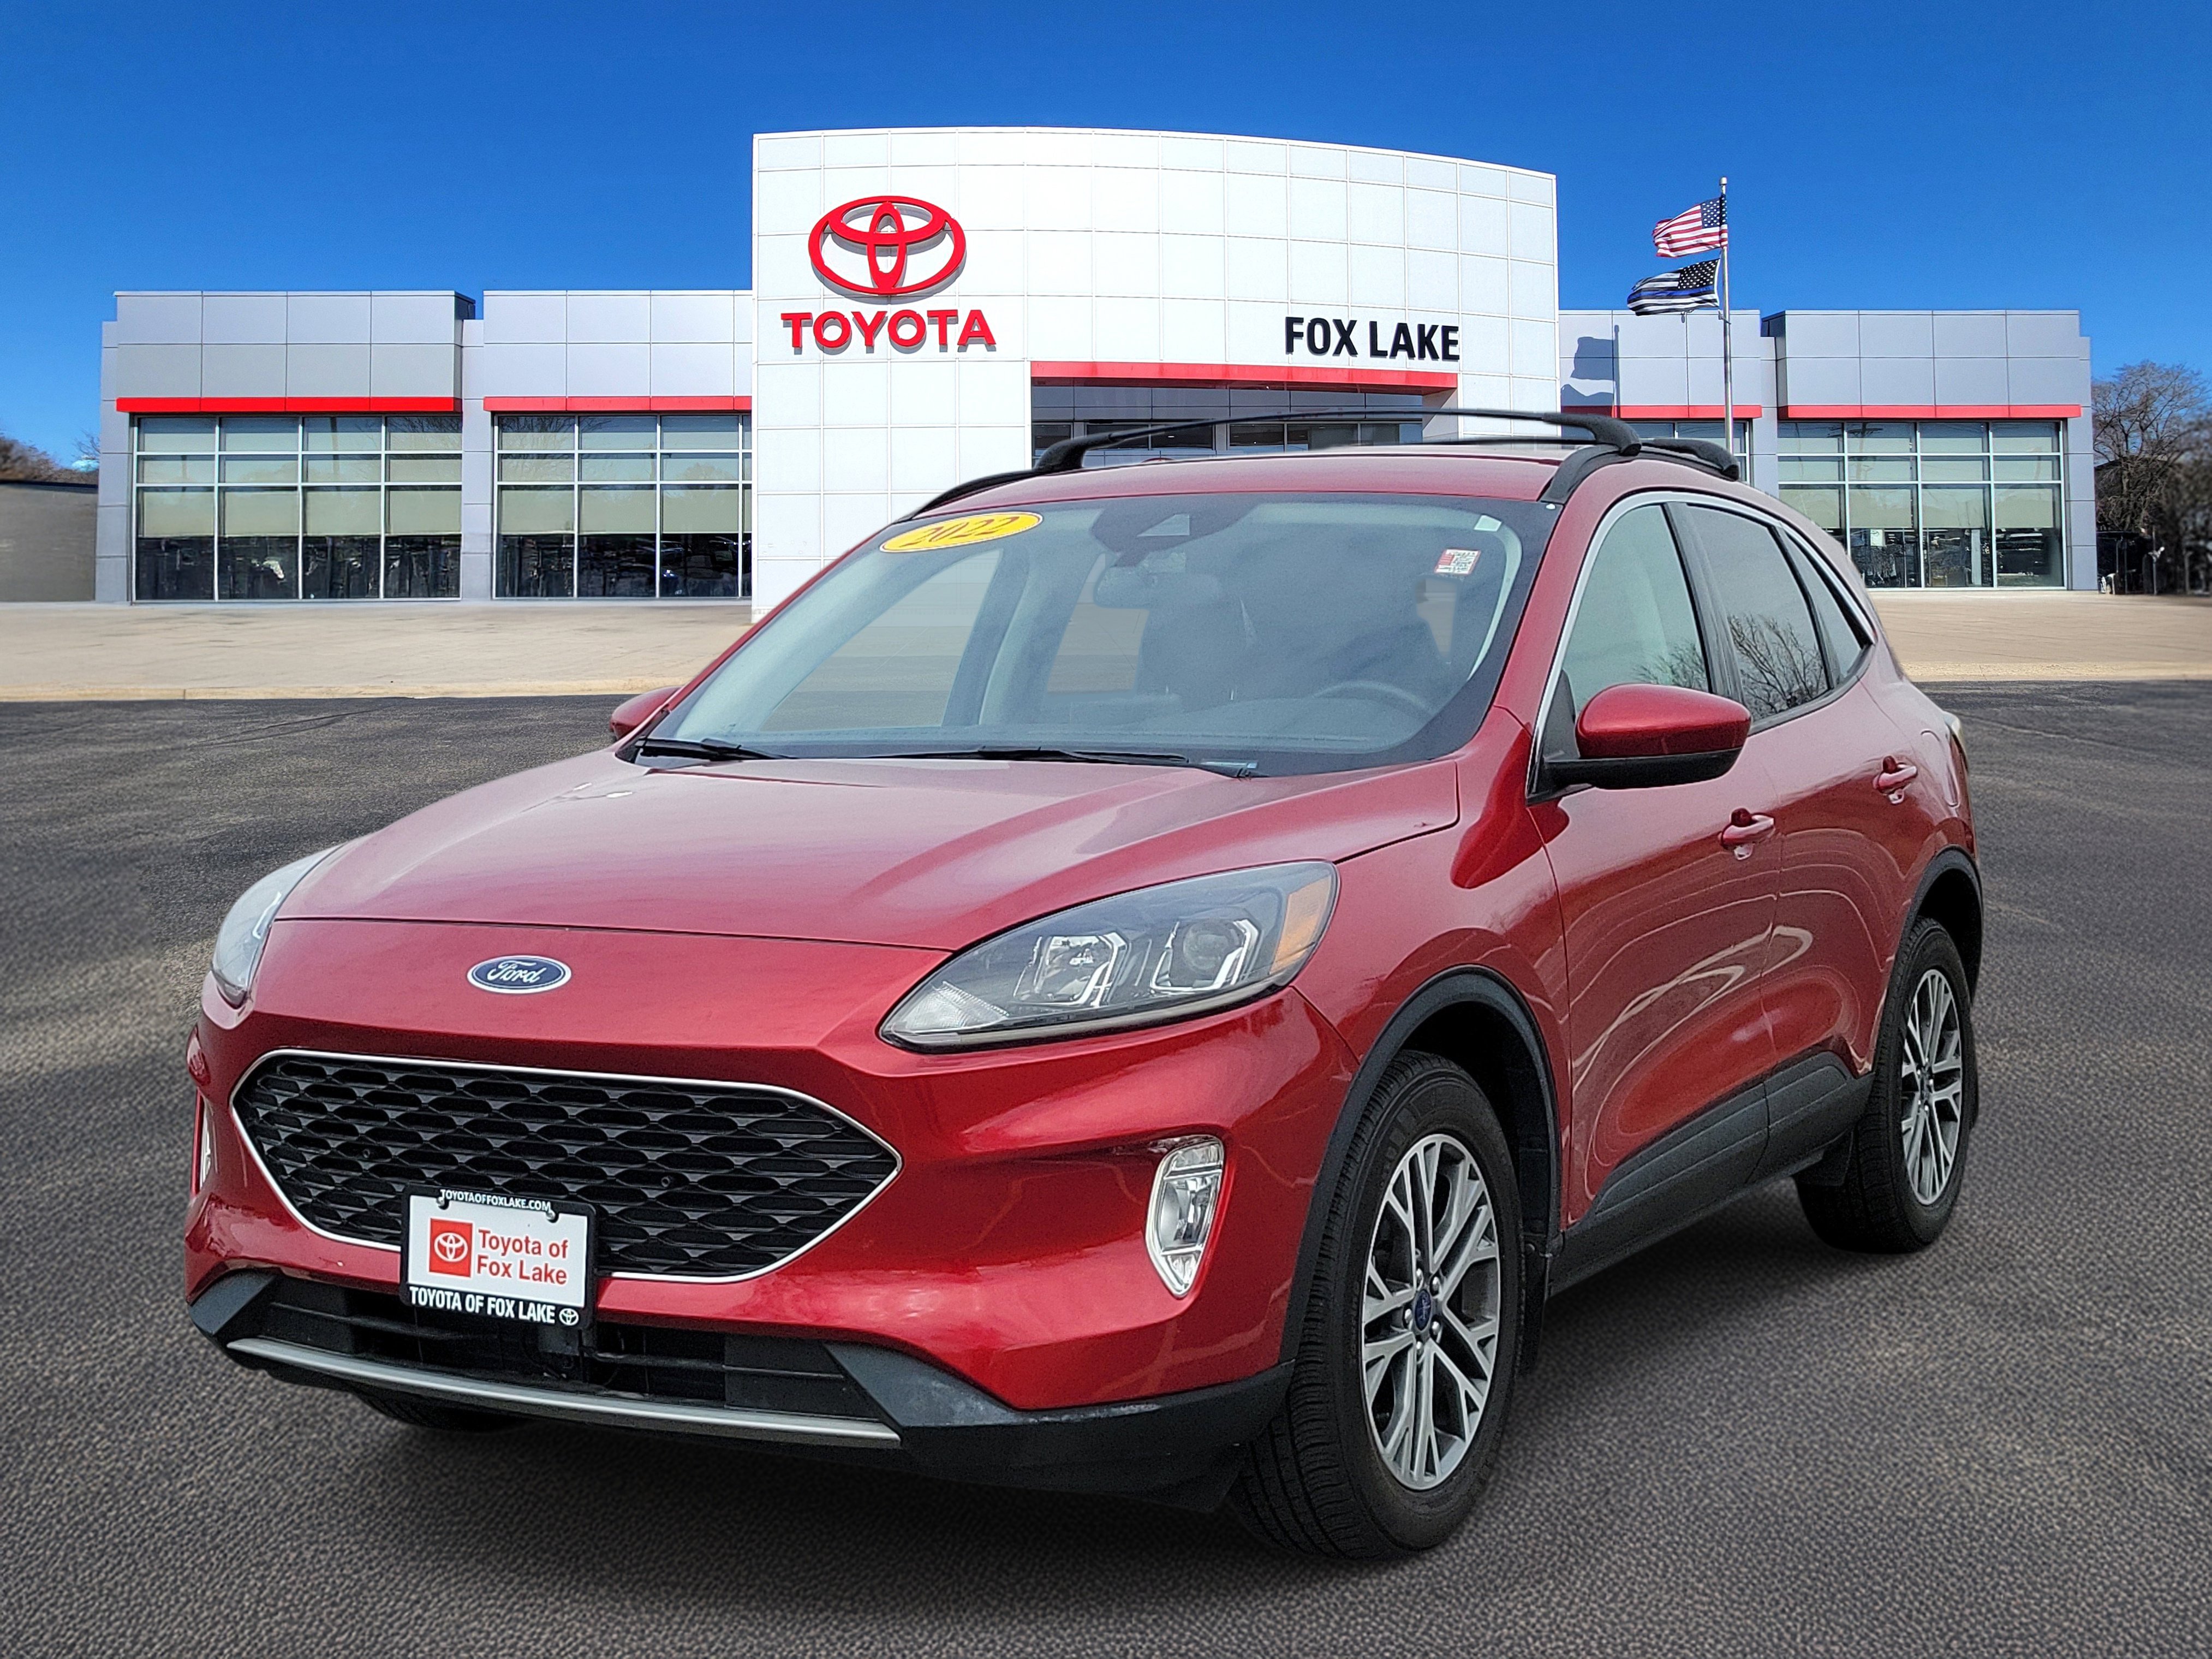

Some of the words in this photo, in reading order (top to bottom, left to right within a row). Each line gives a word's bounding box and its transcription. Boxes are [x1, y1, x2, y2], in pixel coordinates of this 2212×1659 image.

[781, 309, 997, 351] TOYOTA
[1285, 317, 1358, 356] FOX
[1369, 320, 1460, 361] LAKE
[898, 515, 1021, 548] 2022
[487, 960, 546, 983] Ford
[440, 1188, 552, 1211] TOYOTAOFFOXLAKE.COM
[478, 1228, 541, 1256] Toyota
[548, 1239, 569, 1258] of
[476, 1254, 512, 1278] Fox
[519, 1260, 567, 1285] Lake
[409, 1286, 462, 1311] TOYOTA
[466, 1294, 485, 1314] OF
[487, 1297, 515, 1318] FOX
[518, 1301, 556, 1324] LAKE
